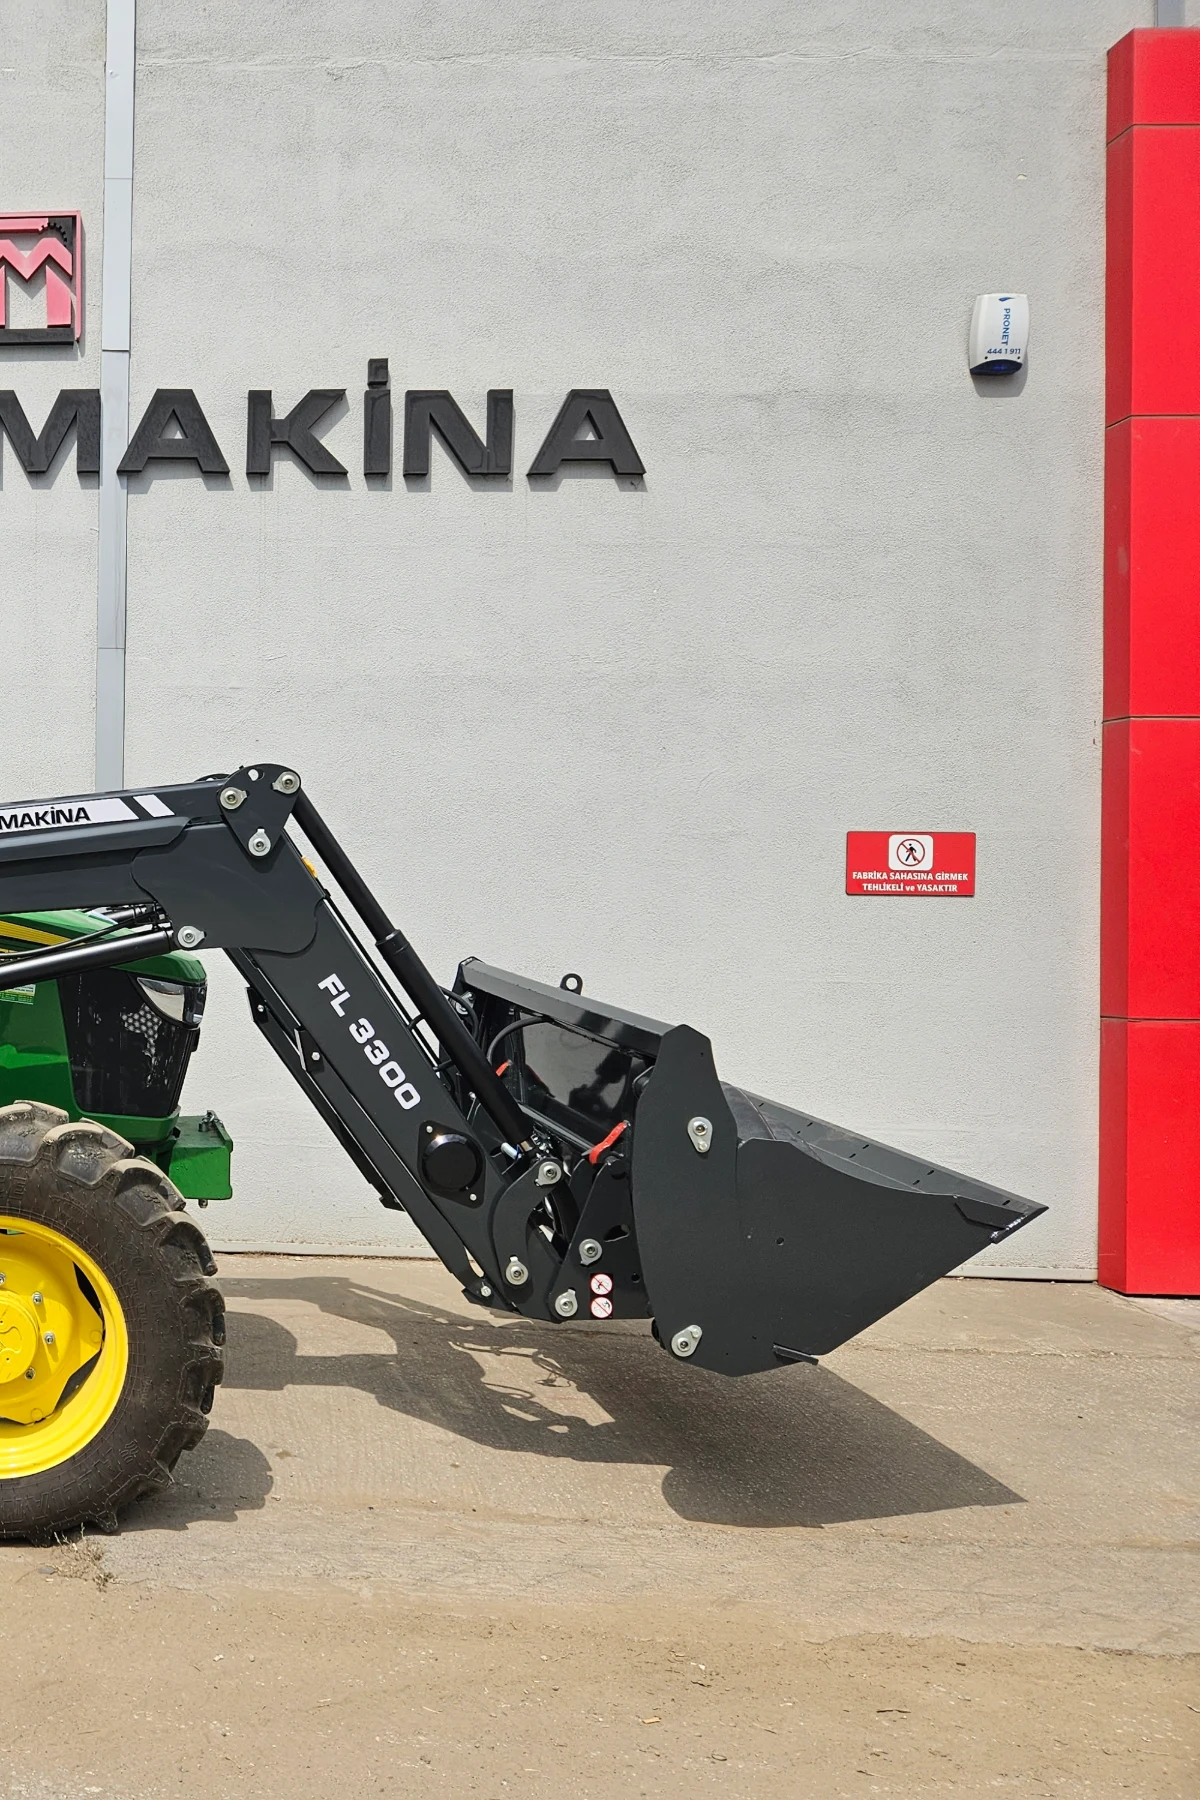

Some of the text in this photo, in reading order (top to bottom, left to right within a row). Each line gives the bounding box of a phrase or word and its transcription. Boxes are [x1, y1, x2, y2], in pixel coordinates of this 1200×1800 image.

[1001, 308, 1011, 346] PRONET
[852, 871, 968, 881] FABRİKA SAHASINA GİRMEK
[862, 882, 904, 891] TEHLİKELİ
[917, 883, 958, 892] YASAKTIR
[317, 973, 421, 1110] FL 3300
